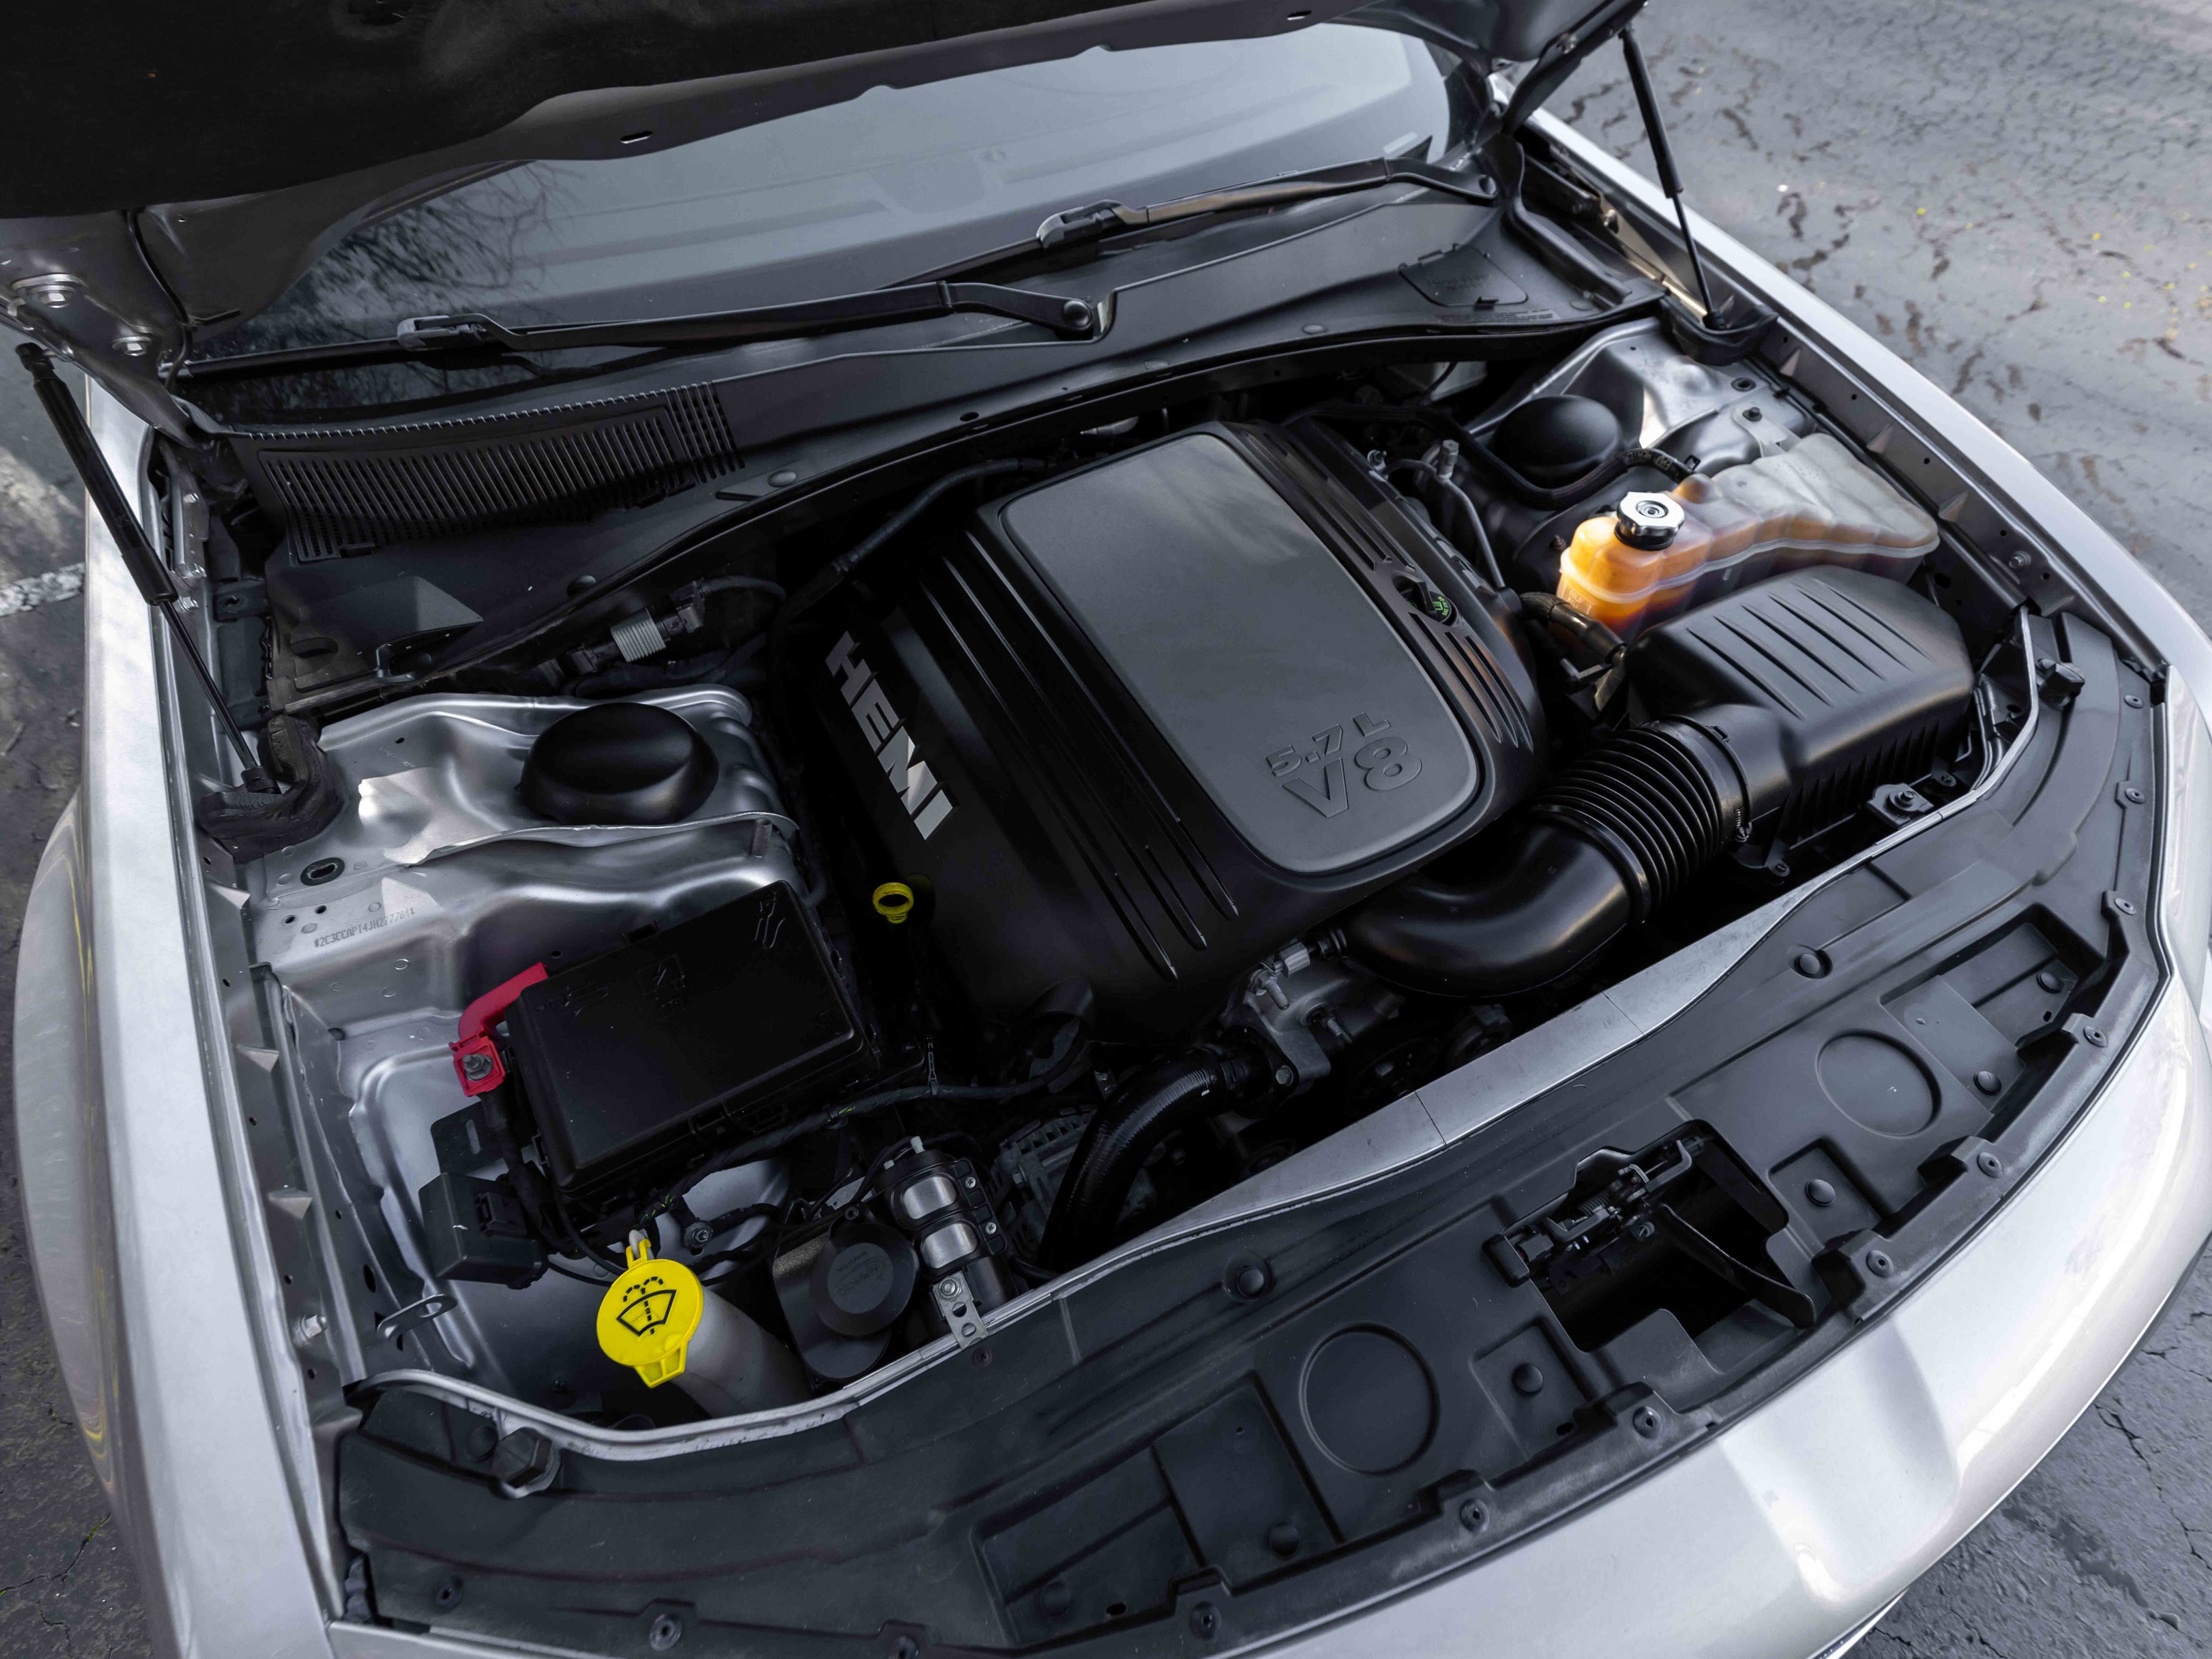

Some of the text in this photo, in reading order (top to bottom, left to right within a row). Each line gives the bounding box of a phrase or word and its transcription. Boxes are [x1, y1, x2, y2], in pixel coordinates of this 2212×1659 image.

[825, 630, 954, 841] HEMI
[1265, 712, 1392, 777] 5.7 L
[1280, 736, 1422, 819] V8
